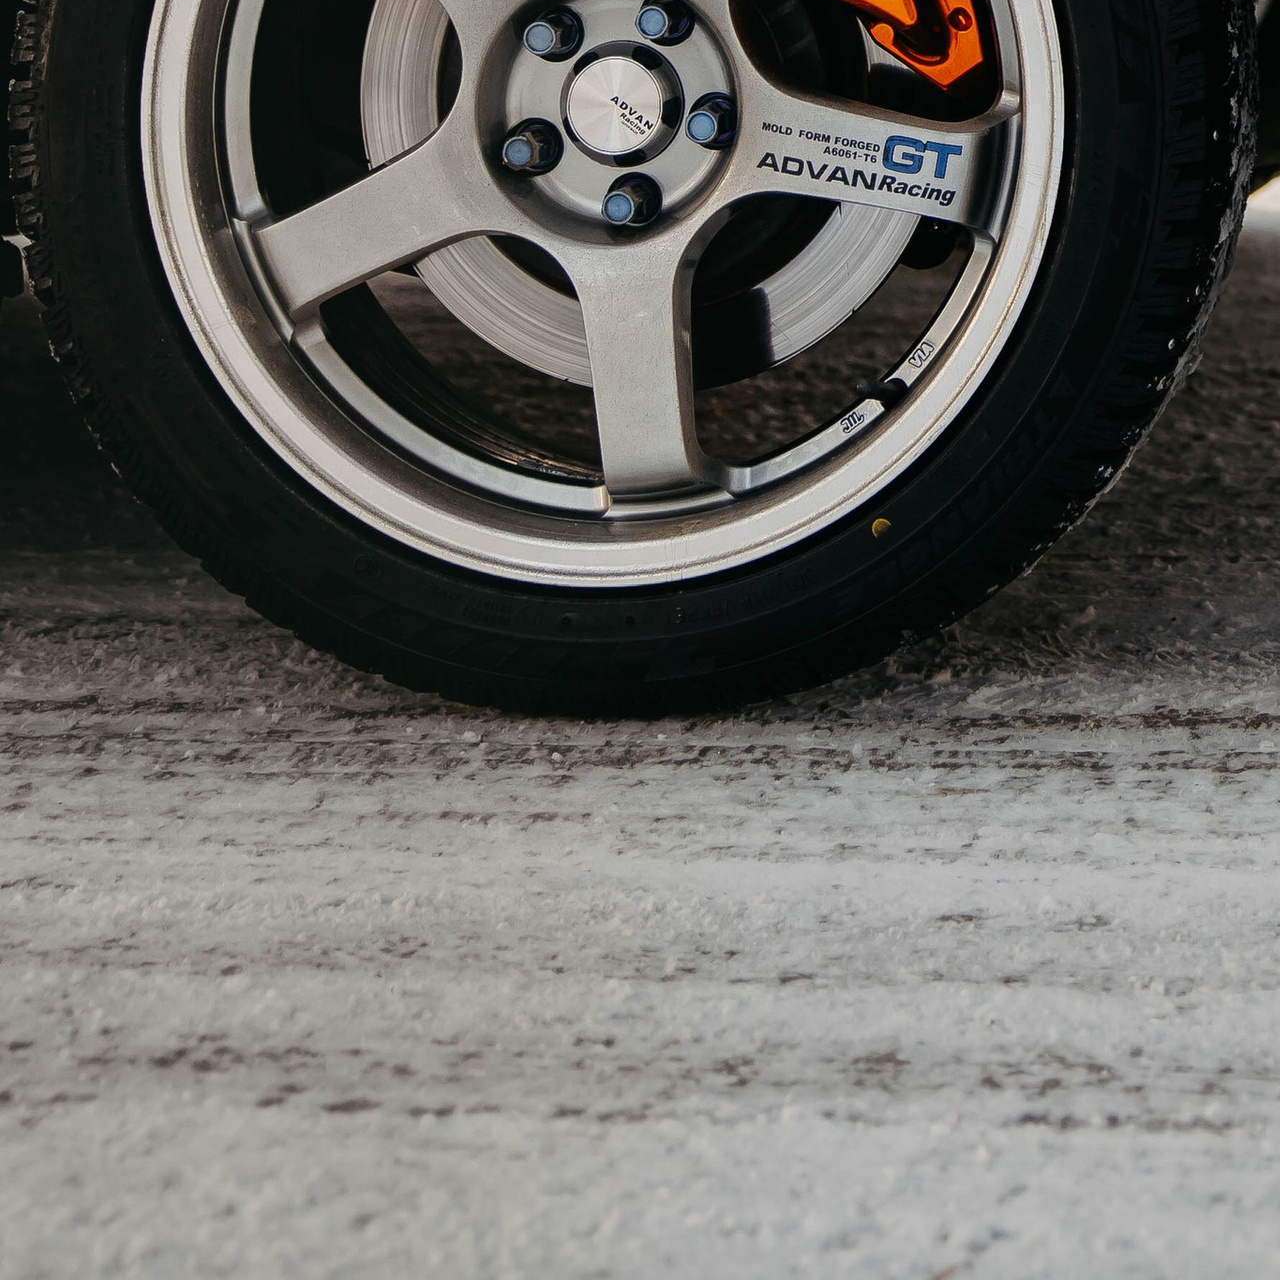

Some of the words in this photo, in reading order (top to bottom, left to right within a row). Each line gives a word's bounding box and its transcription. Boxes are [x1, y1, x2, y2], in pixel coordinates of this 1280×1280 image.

[610, 96, 654, 130] ADVAN
[762, 122, 793, 136] MOLD
[798, 130, 831, 143] FORM
[834, 136, 881, 153] FORGED
[823, 146, 877, 163] A6061-T6
[882, 135, 963, 179] GT
